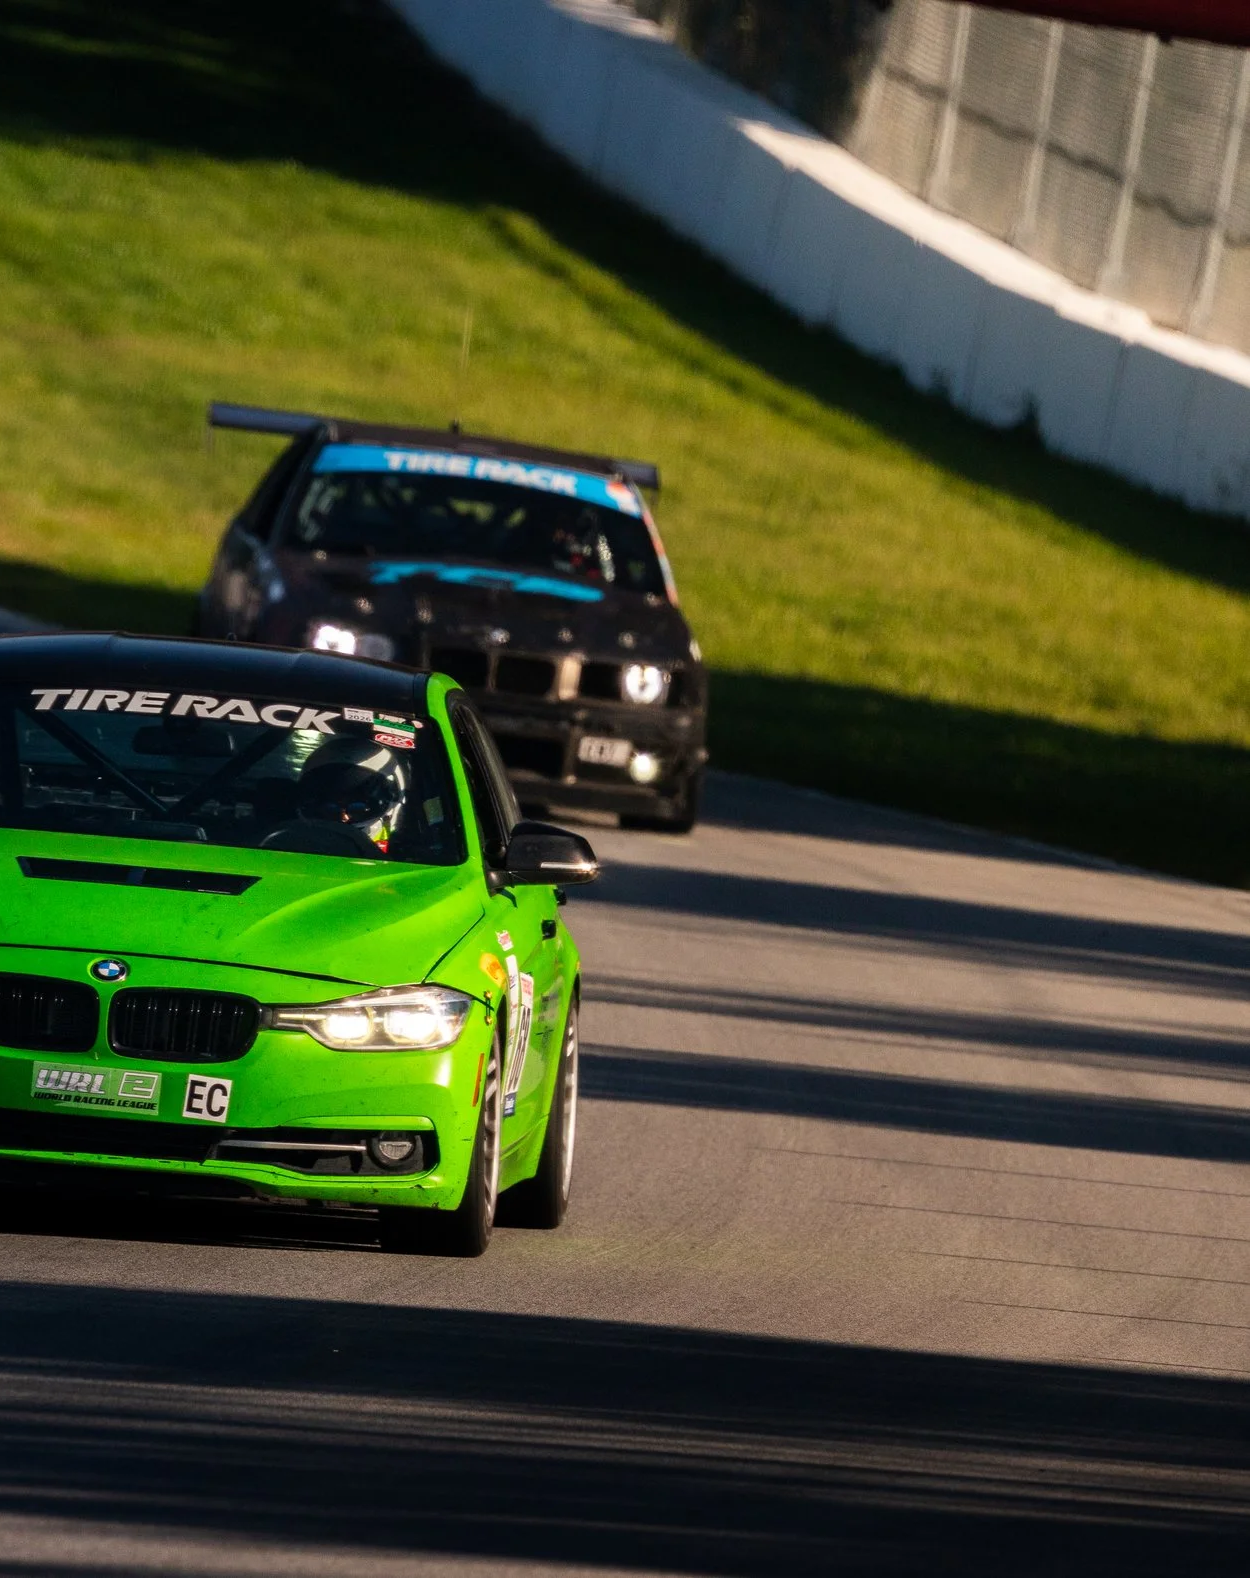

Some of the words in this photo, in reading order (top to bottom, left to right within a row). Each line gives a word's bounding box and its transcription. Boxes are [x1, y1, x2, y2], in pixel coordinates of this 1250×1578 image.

[385, 451, 471, 475] TIRE
[475, 458, 576, 495] RACK
[31, 689, 171, 713] TIRE
[170, 694, 341, 735] RACK
[348, 714, 372, 722] 2026
[36, 1069, 105, 1094] WRL
[33, 1091, 73, 1104] WORLD
[73, 1095, 116, 1107] RACING
[116, 1099, 158, 1112] LEAGUE
[186, 1080, 228, 1117] EC
